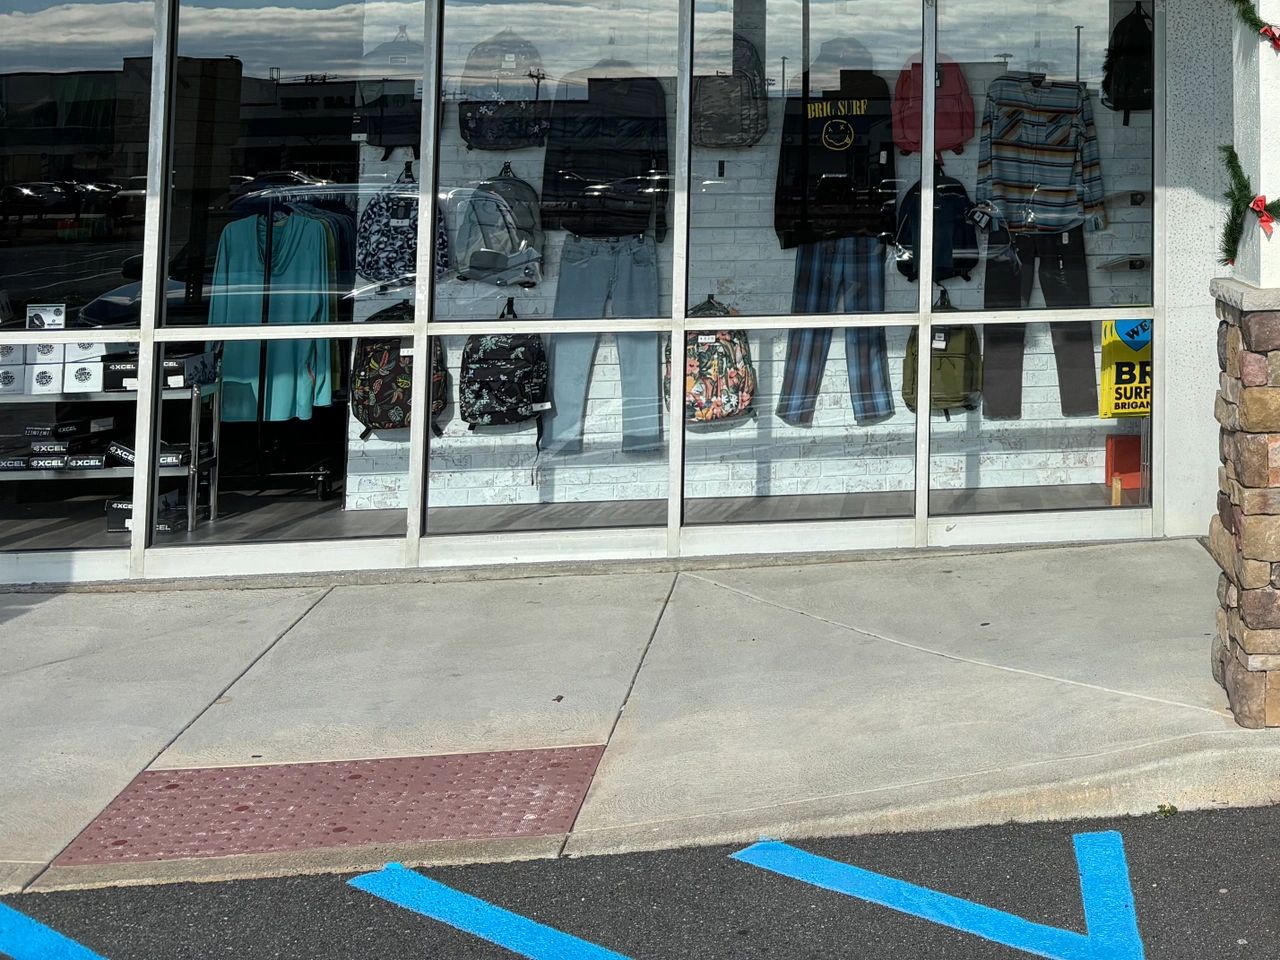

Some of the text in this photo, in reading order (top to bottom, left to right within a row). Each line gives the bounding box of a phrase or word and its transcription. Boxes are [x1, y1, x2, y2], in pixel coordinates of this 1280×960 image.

[807, 99, 868, 119] BRIG SURF
[1114, 386, 1151, 401] SURF
